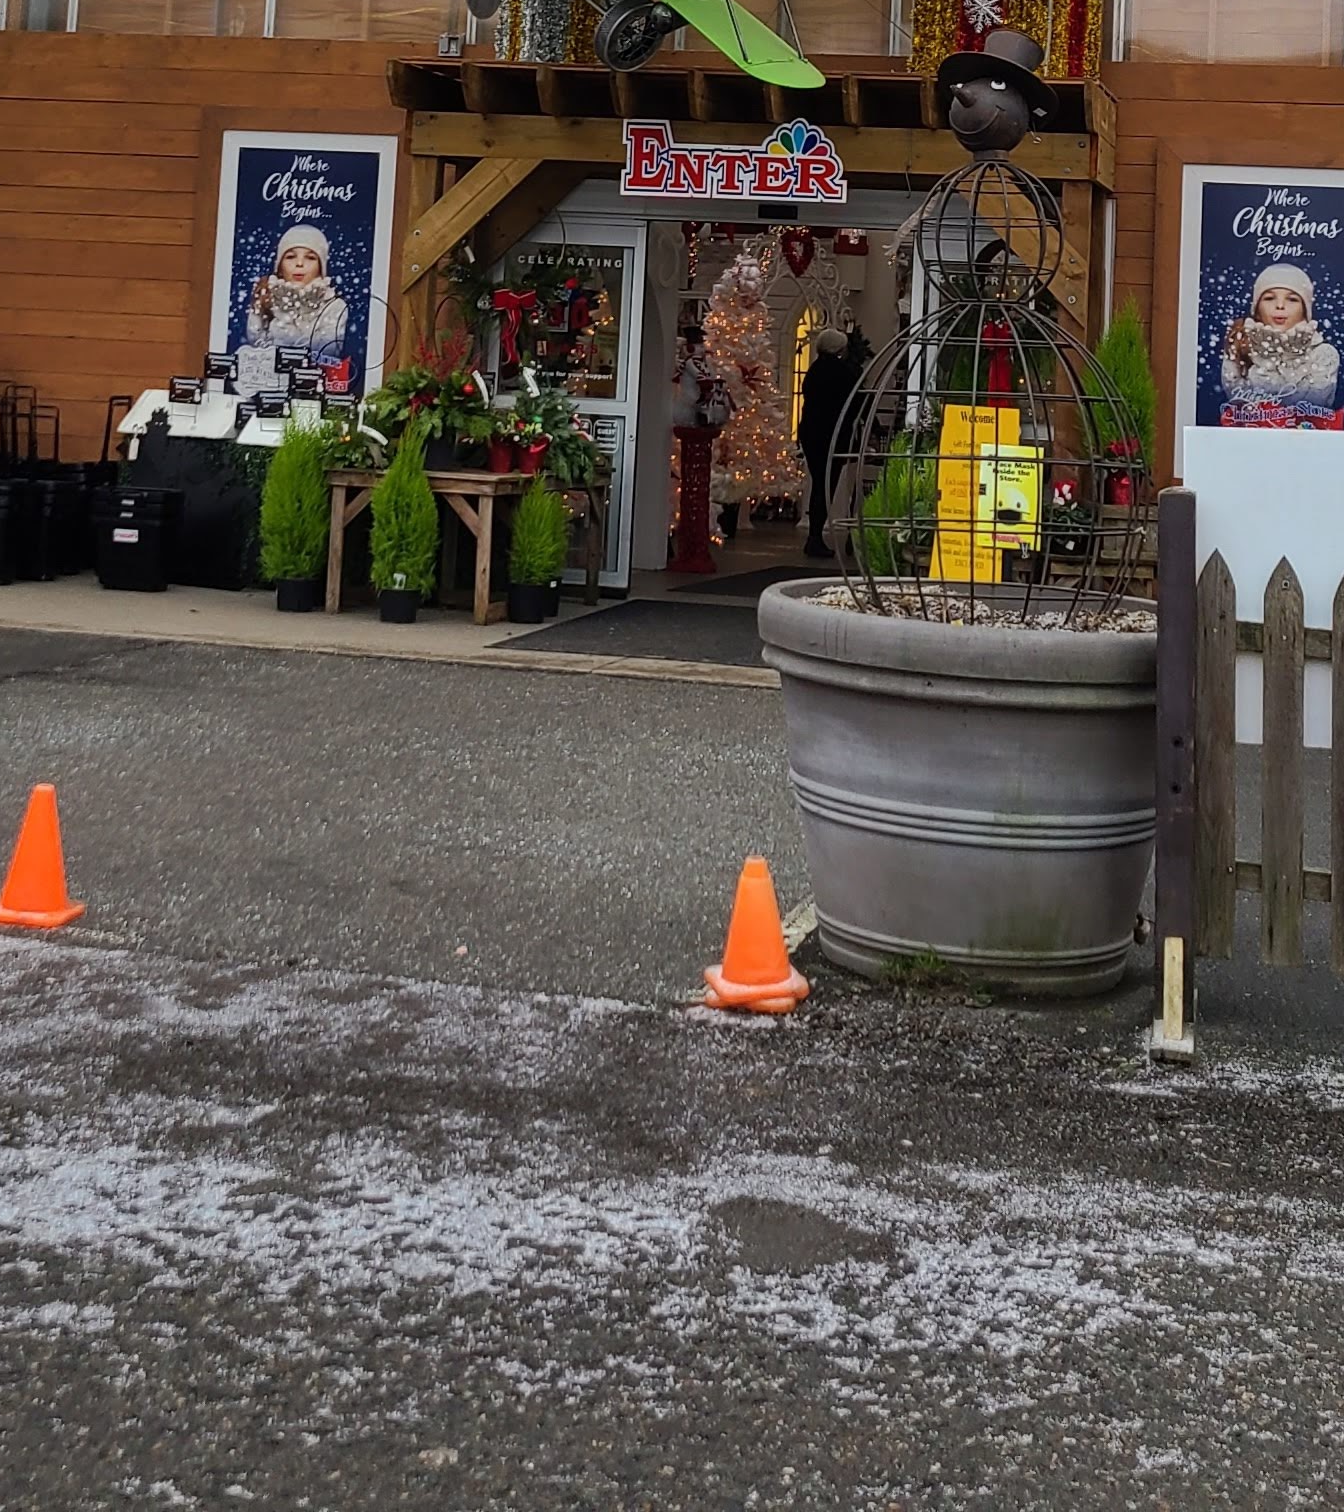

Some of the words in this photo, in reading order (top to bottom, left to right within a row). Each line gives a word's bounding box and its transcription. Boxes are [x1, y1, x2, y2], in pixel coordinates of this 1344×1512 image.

[290, 154, 331, 174] Where
[626, 126, 840, 196] ENTER
[262, 172, 357, 202] Christmas
[1264, 188, 1311, 208] Where
[281, 201, 333, 223] Begins...
[1232, 206, 1343, 239] Christmas
[1256, 238, 1316, 261] Begins...
[585, 373, 613, 381] support
[960, 411, 995, 424] Wecome
[1014, 462, 1035, 470] Mask
[999, 475, 1023, 483] Store.
